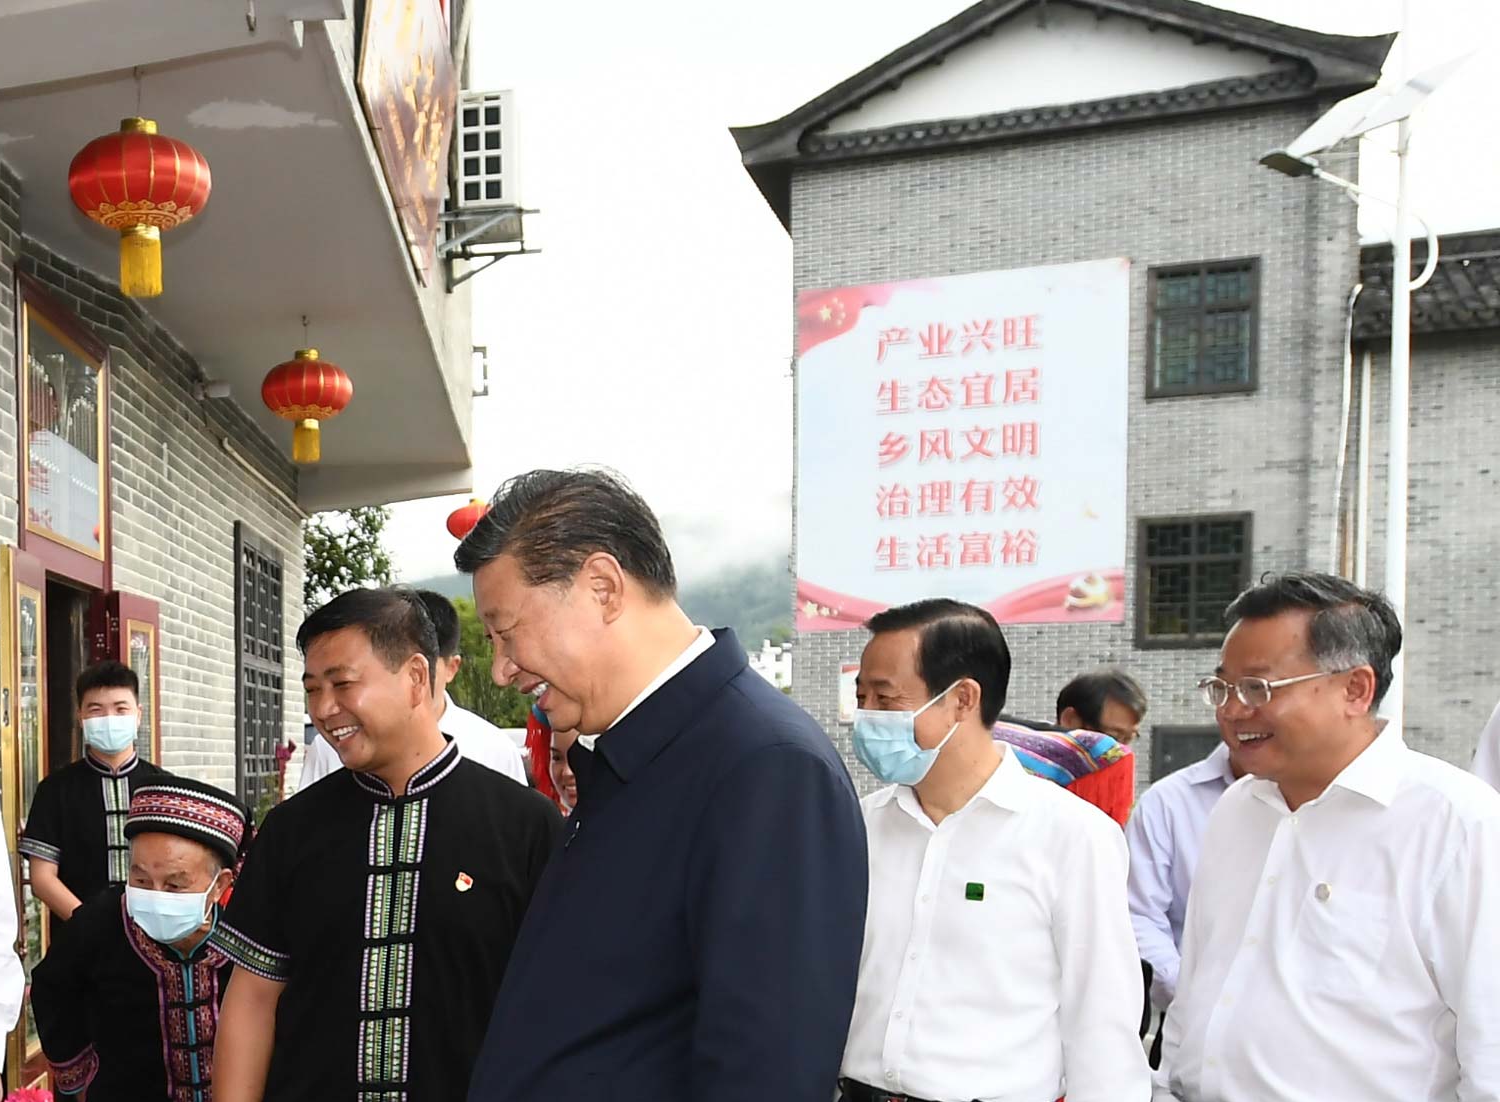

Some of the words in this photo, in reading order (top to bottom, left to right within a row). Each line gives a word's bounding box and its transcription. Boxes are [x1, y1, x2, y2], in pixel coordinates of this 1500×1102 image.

[876, 314, 1039, 362] 产业兴旺
[876, 367, 1040, 415] 生态宜居
[878, 421, 1040, 466] 乡风文明
[876, 475, 1039, 518] 治理有效
[875, 529, 1038, 571] 生活富裕
